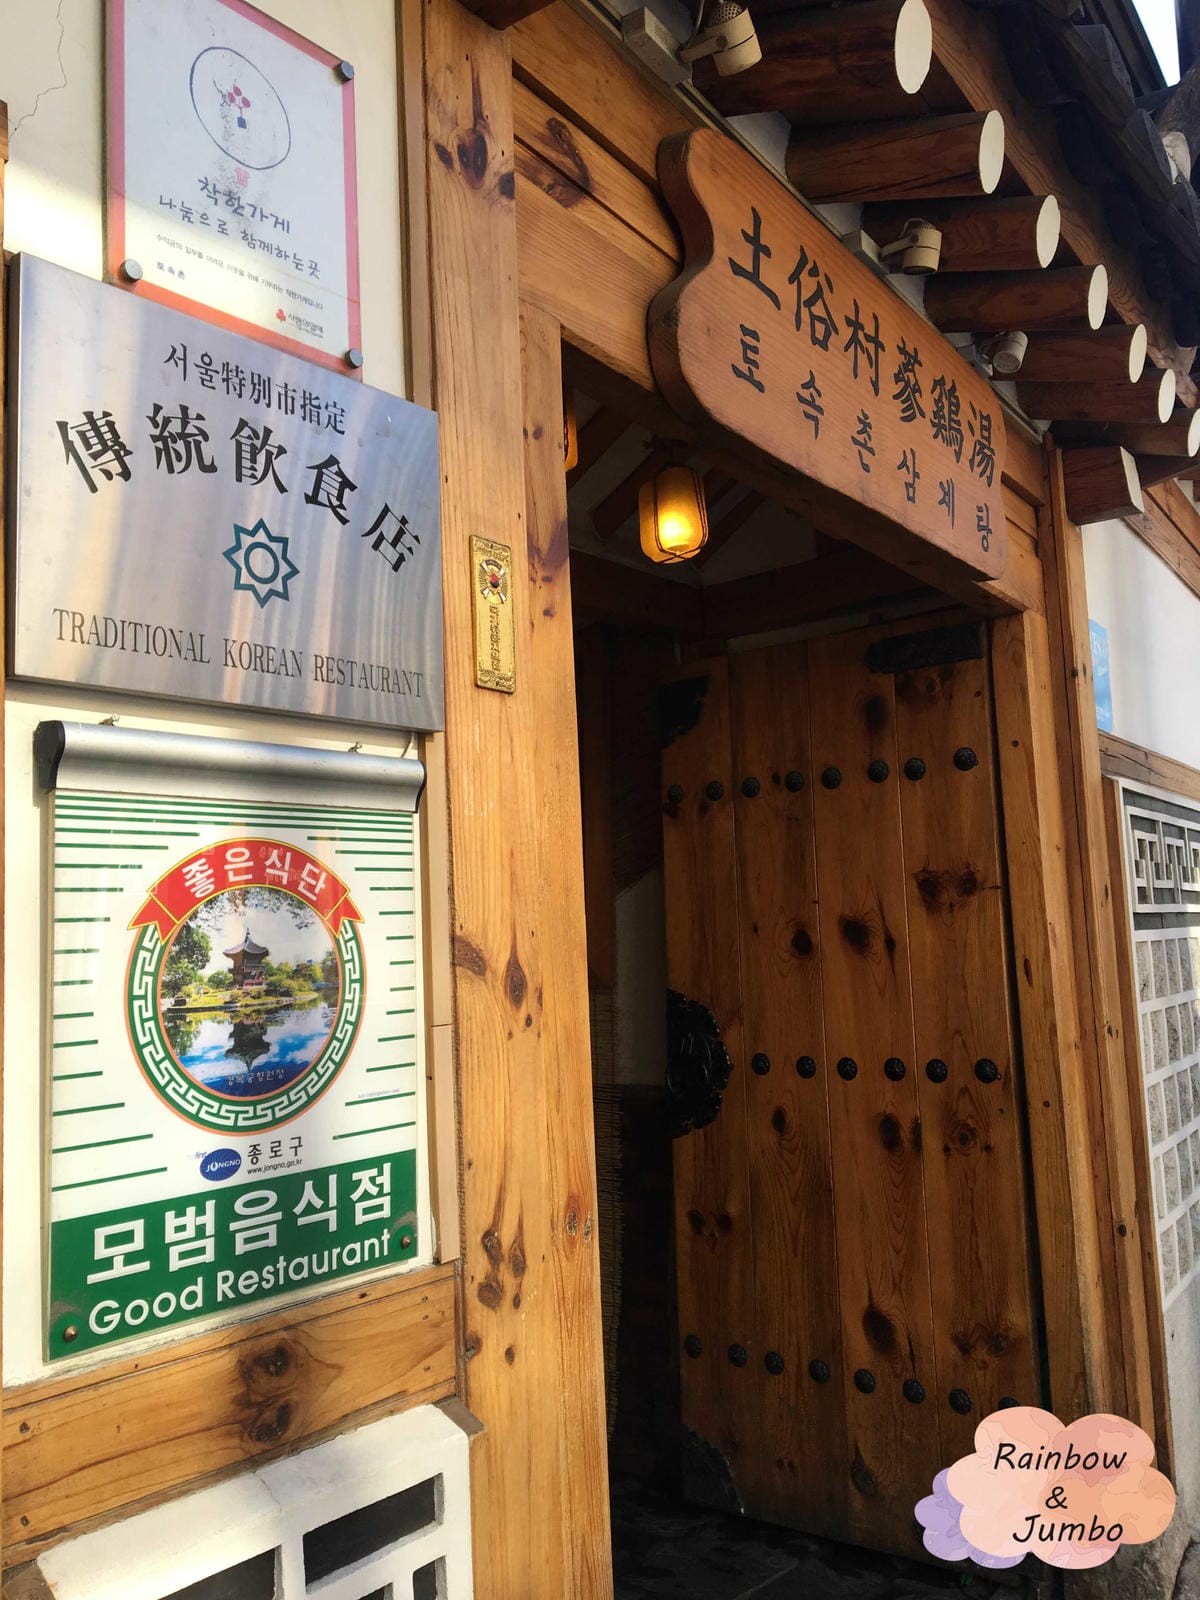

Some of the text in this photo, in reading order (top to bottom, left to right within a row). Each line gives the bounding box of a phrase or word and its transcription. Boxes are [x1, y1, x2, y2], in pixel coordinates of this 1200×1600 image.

[159, 194, 230, 237] 나눔으로
[198, 176, 291, 234] 착한가게
[163, 342, 347, 436] 서울特別市指定
[52, 608, 423, 699] TRADITIONAL KOREAN RESTAURANT
[181, 846, 328, 902] 좋은식단
[205, 1158, 240, 1173] JONGNO
[246, 1157, 304, 1175] www.jongno.go.kr
[247, 1135, 304, 1166] 종로구
[86, 1161, 393, 1285] 모범음식점
[88, 1227, 391, 1335] Good Restaurant
